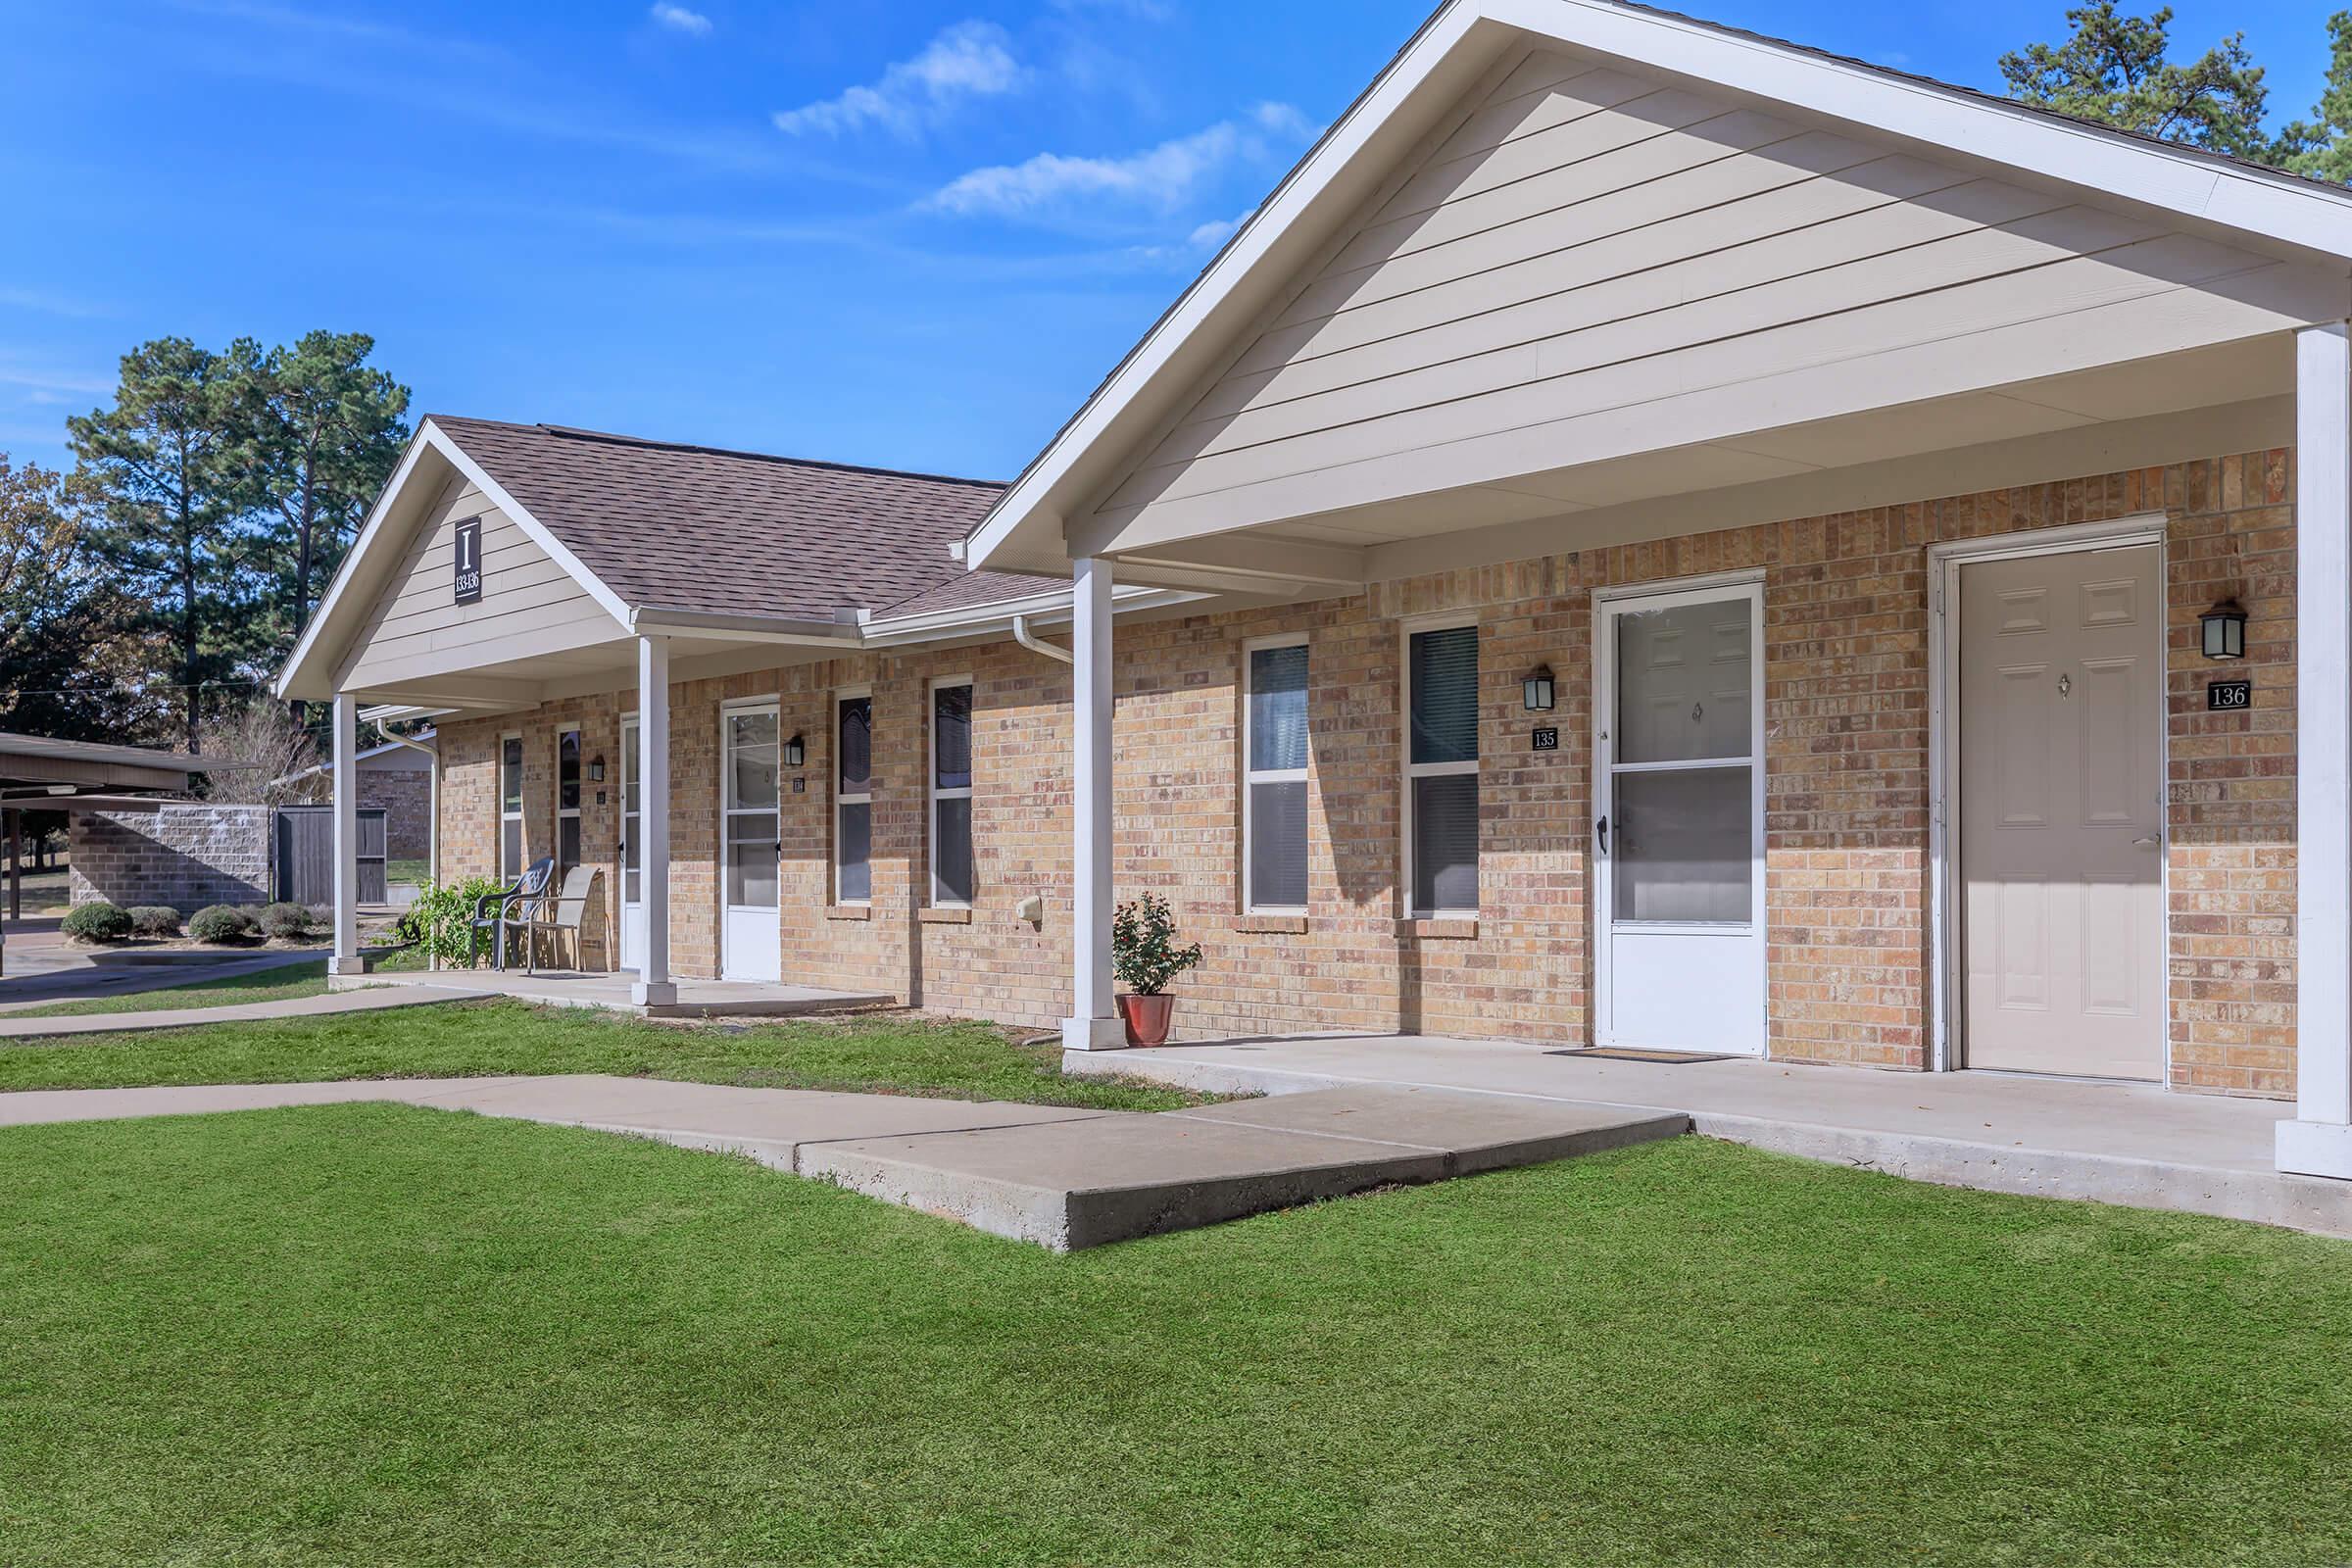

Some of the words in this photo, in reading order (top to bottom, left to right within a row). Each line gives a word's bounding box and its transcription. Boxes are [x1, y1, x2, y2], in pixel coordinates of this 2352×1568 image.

[462, 530, 471, 570] I
[456, 571, 479, 592] 133-136
[2213, 687, 2245, 706] 136
[1536, 732, 1554, 747] 135
